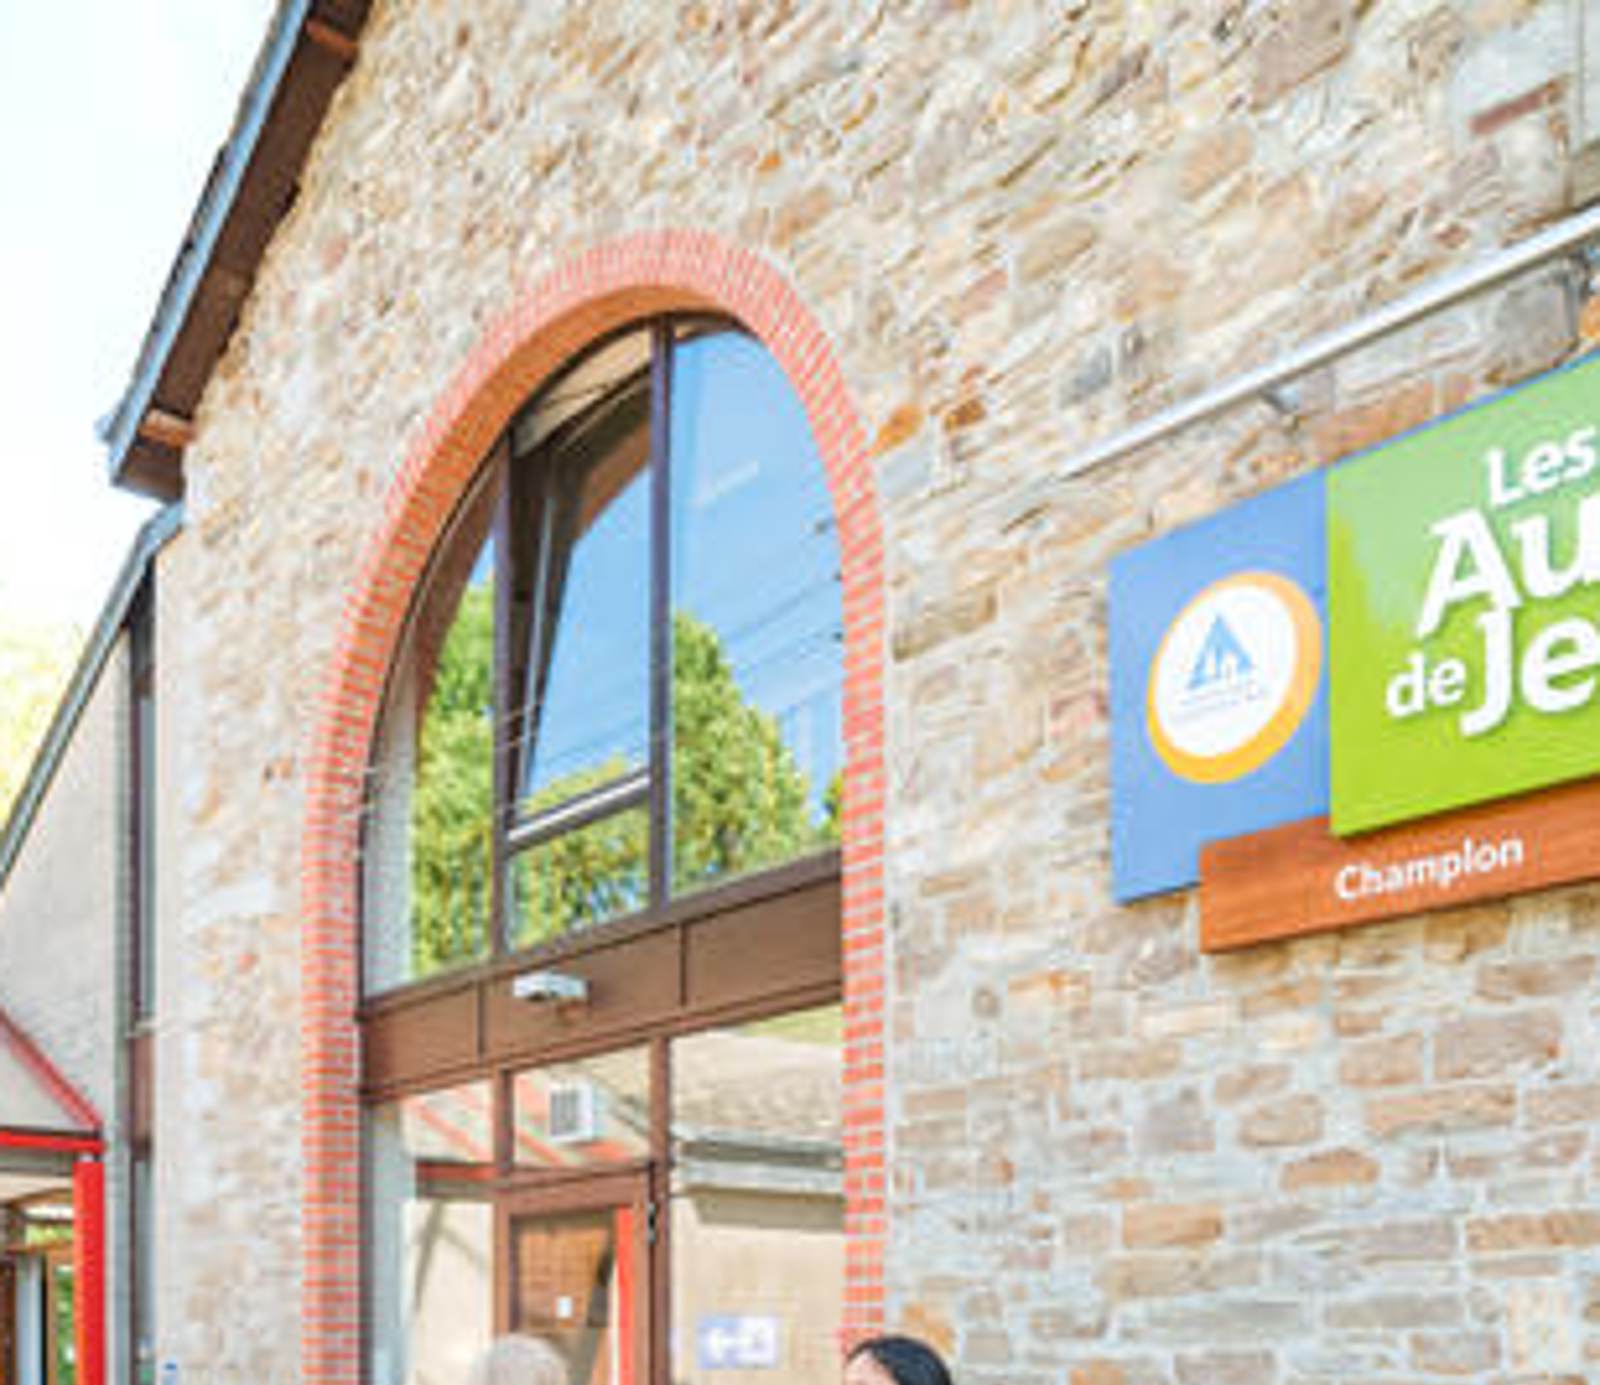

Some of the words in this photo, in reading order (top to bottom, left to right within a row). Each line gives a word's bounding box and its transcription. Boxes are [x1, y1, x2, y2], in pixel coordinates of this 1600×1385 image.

[1484, 425, 1596, 505] Les
[1415, 495, 1600, 638] Au
[1385, 650, 1467, 719] de
[1459, 604, 1600, 737] Je
